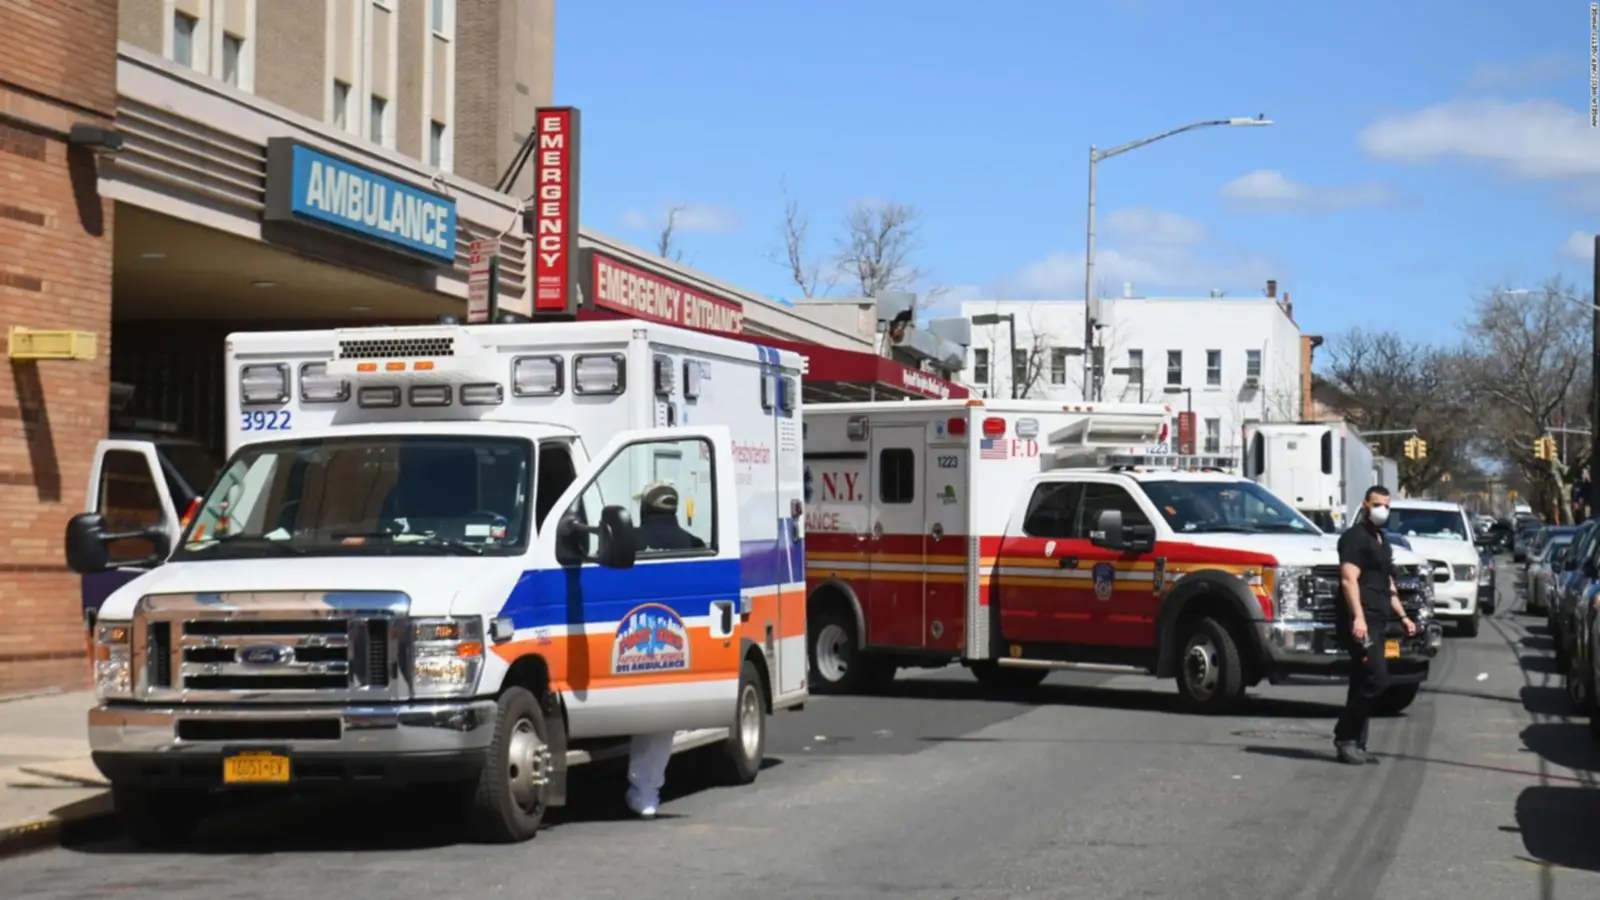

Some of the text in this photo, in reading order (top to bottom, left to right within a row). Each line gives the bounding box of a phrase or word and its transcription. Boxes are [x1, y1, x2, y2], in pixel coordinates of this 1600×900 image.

[306, 160, 448, 249] AMBULANCE
[540, 116, 565, 268] EMERGENCY
[598, 262, 742, 334] EMERGENCY ENTRANCE
[240, 410, 292, 431] 3922
[821, 472, 862, 501] N.Y.
[937, 455, 958, 468] 1223
